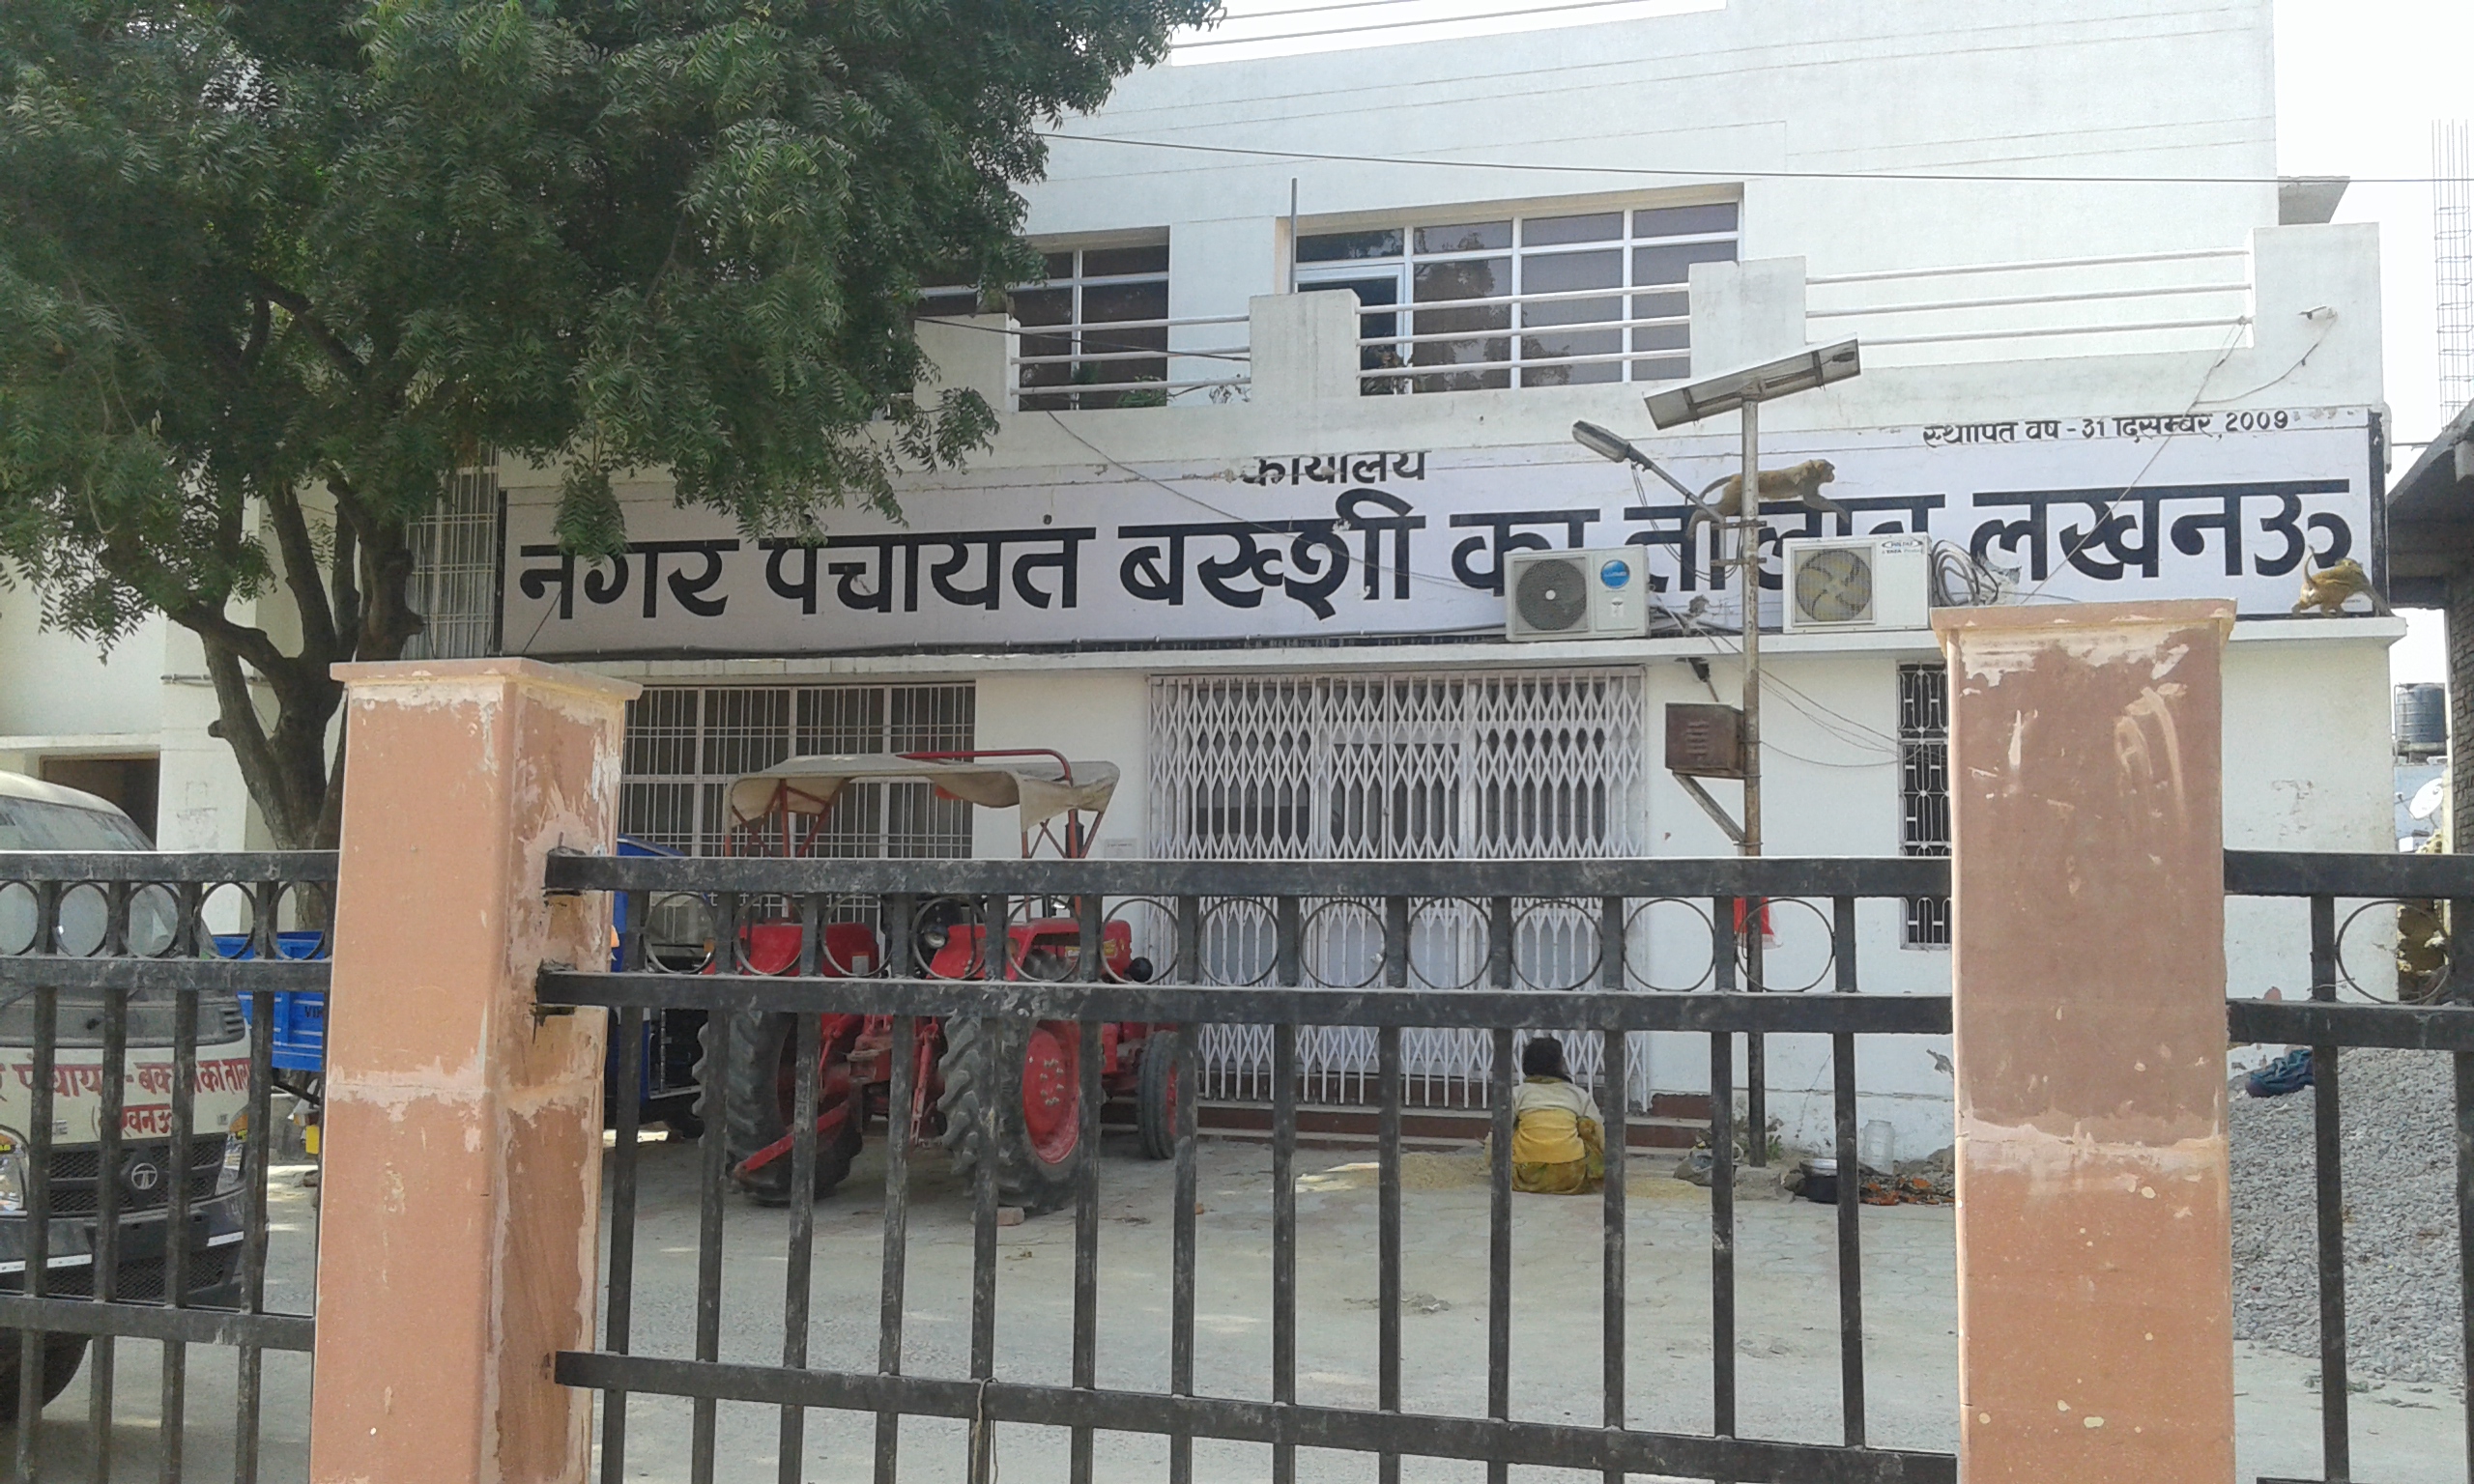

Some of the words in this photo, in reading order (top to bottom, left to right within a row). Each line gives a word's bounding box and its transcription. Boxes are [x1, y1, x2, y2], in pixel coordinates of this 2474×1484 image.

[2225, 410, 2289, 433] 2009
[520, 538, 740, 620] नगर
[1117, 487, 1427, 621] बख्शी
[1970, 478, 2354, 584] लखनऊ
